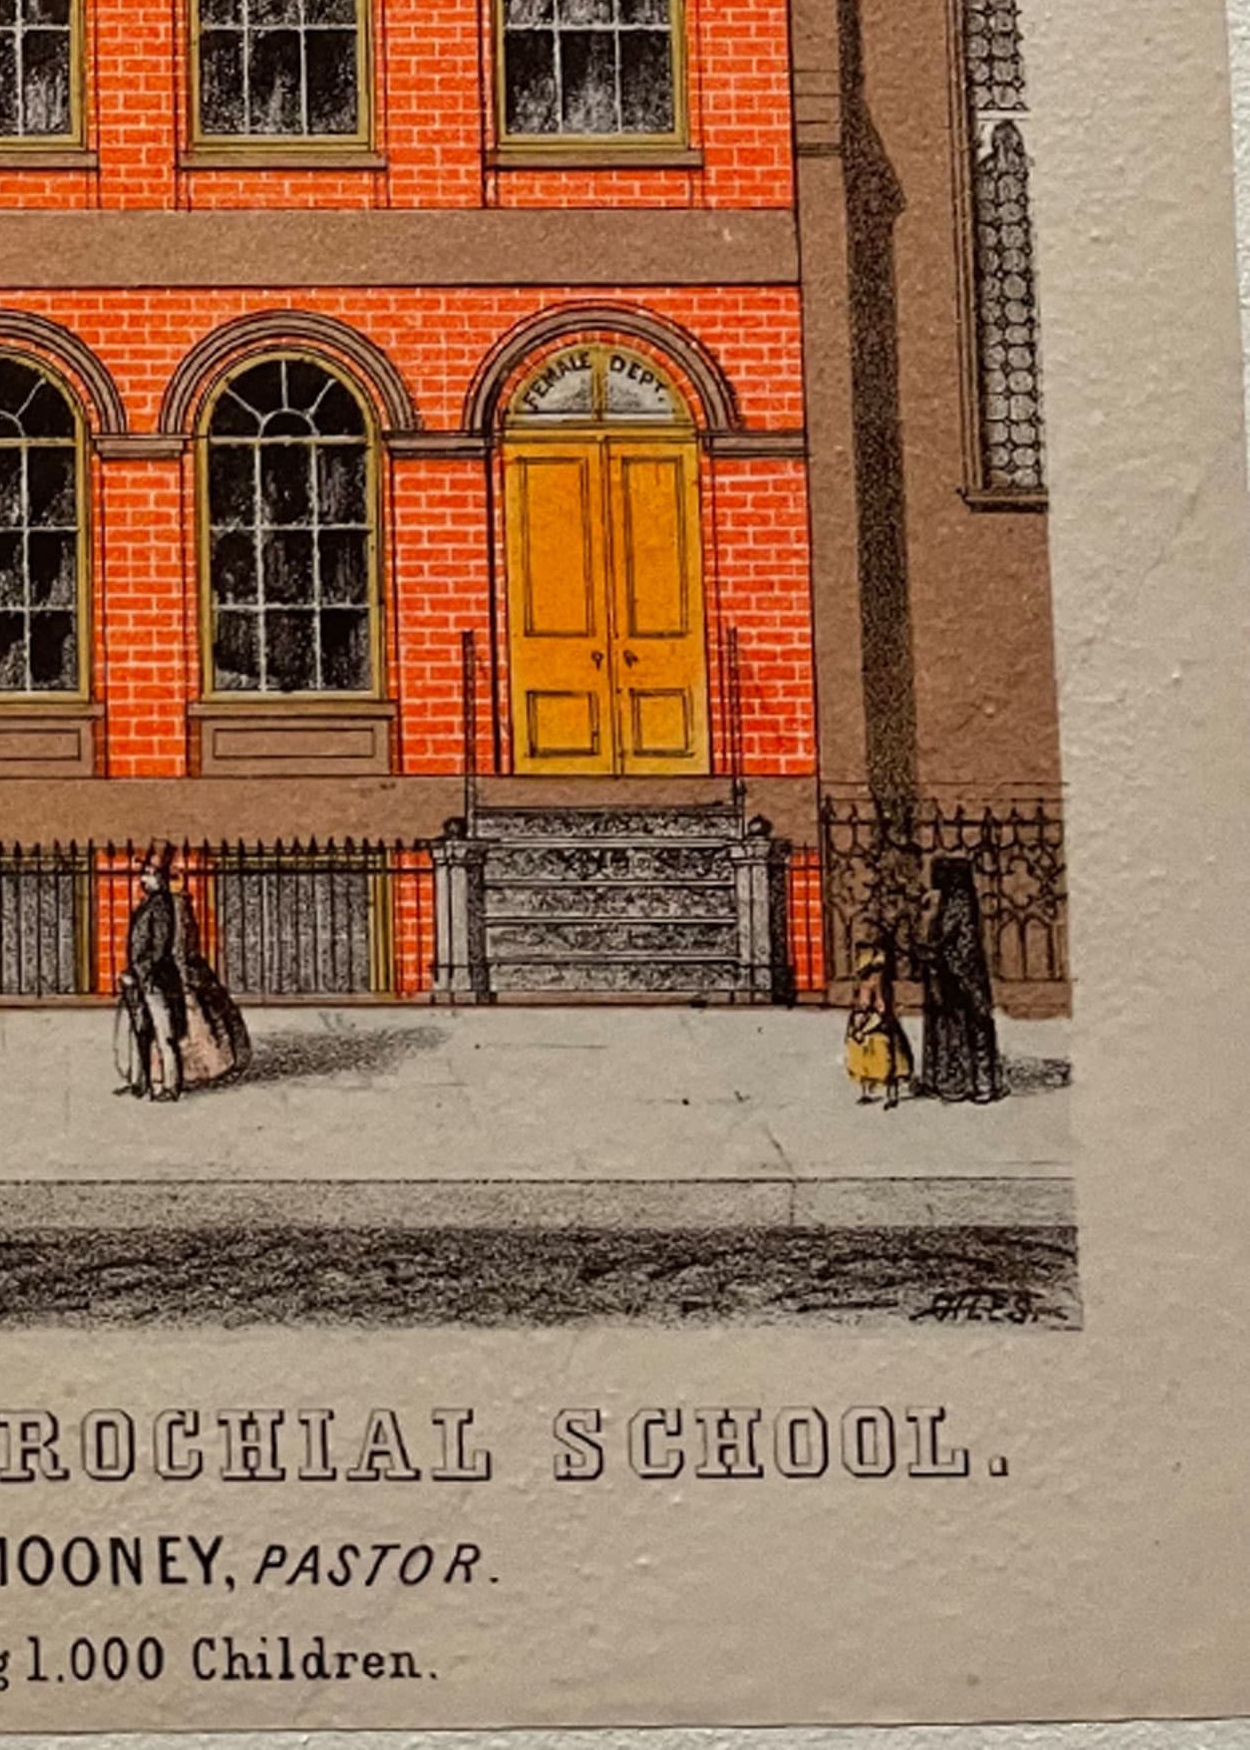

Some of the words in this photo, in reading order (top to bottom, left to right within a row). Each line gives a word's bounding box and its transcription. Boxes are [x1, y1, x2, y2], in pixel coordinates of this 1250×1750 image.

[522, 351, 592, 411] FEMALE
[553, 1405, 1010, 1482] SCHOOL.
[252, 1543, 502, 1589] PASTOR.
[192, 1636, 440, 1683] Children.
